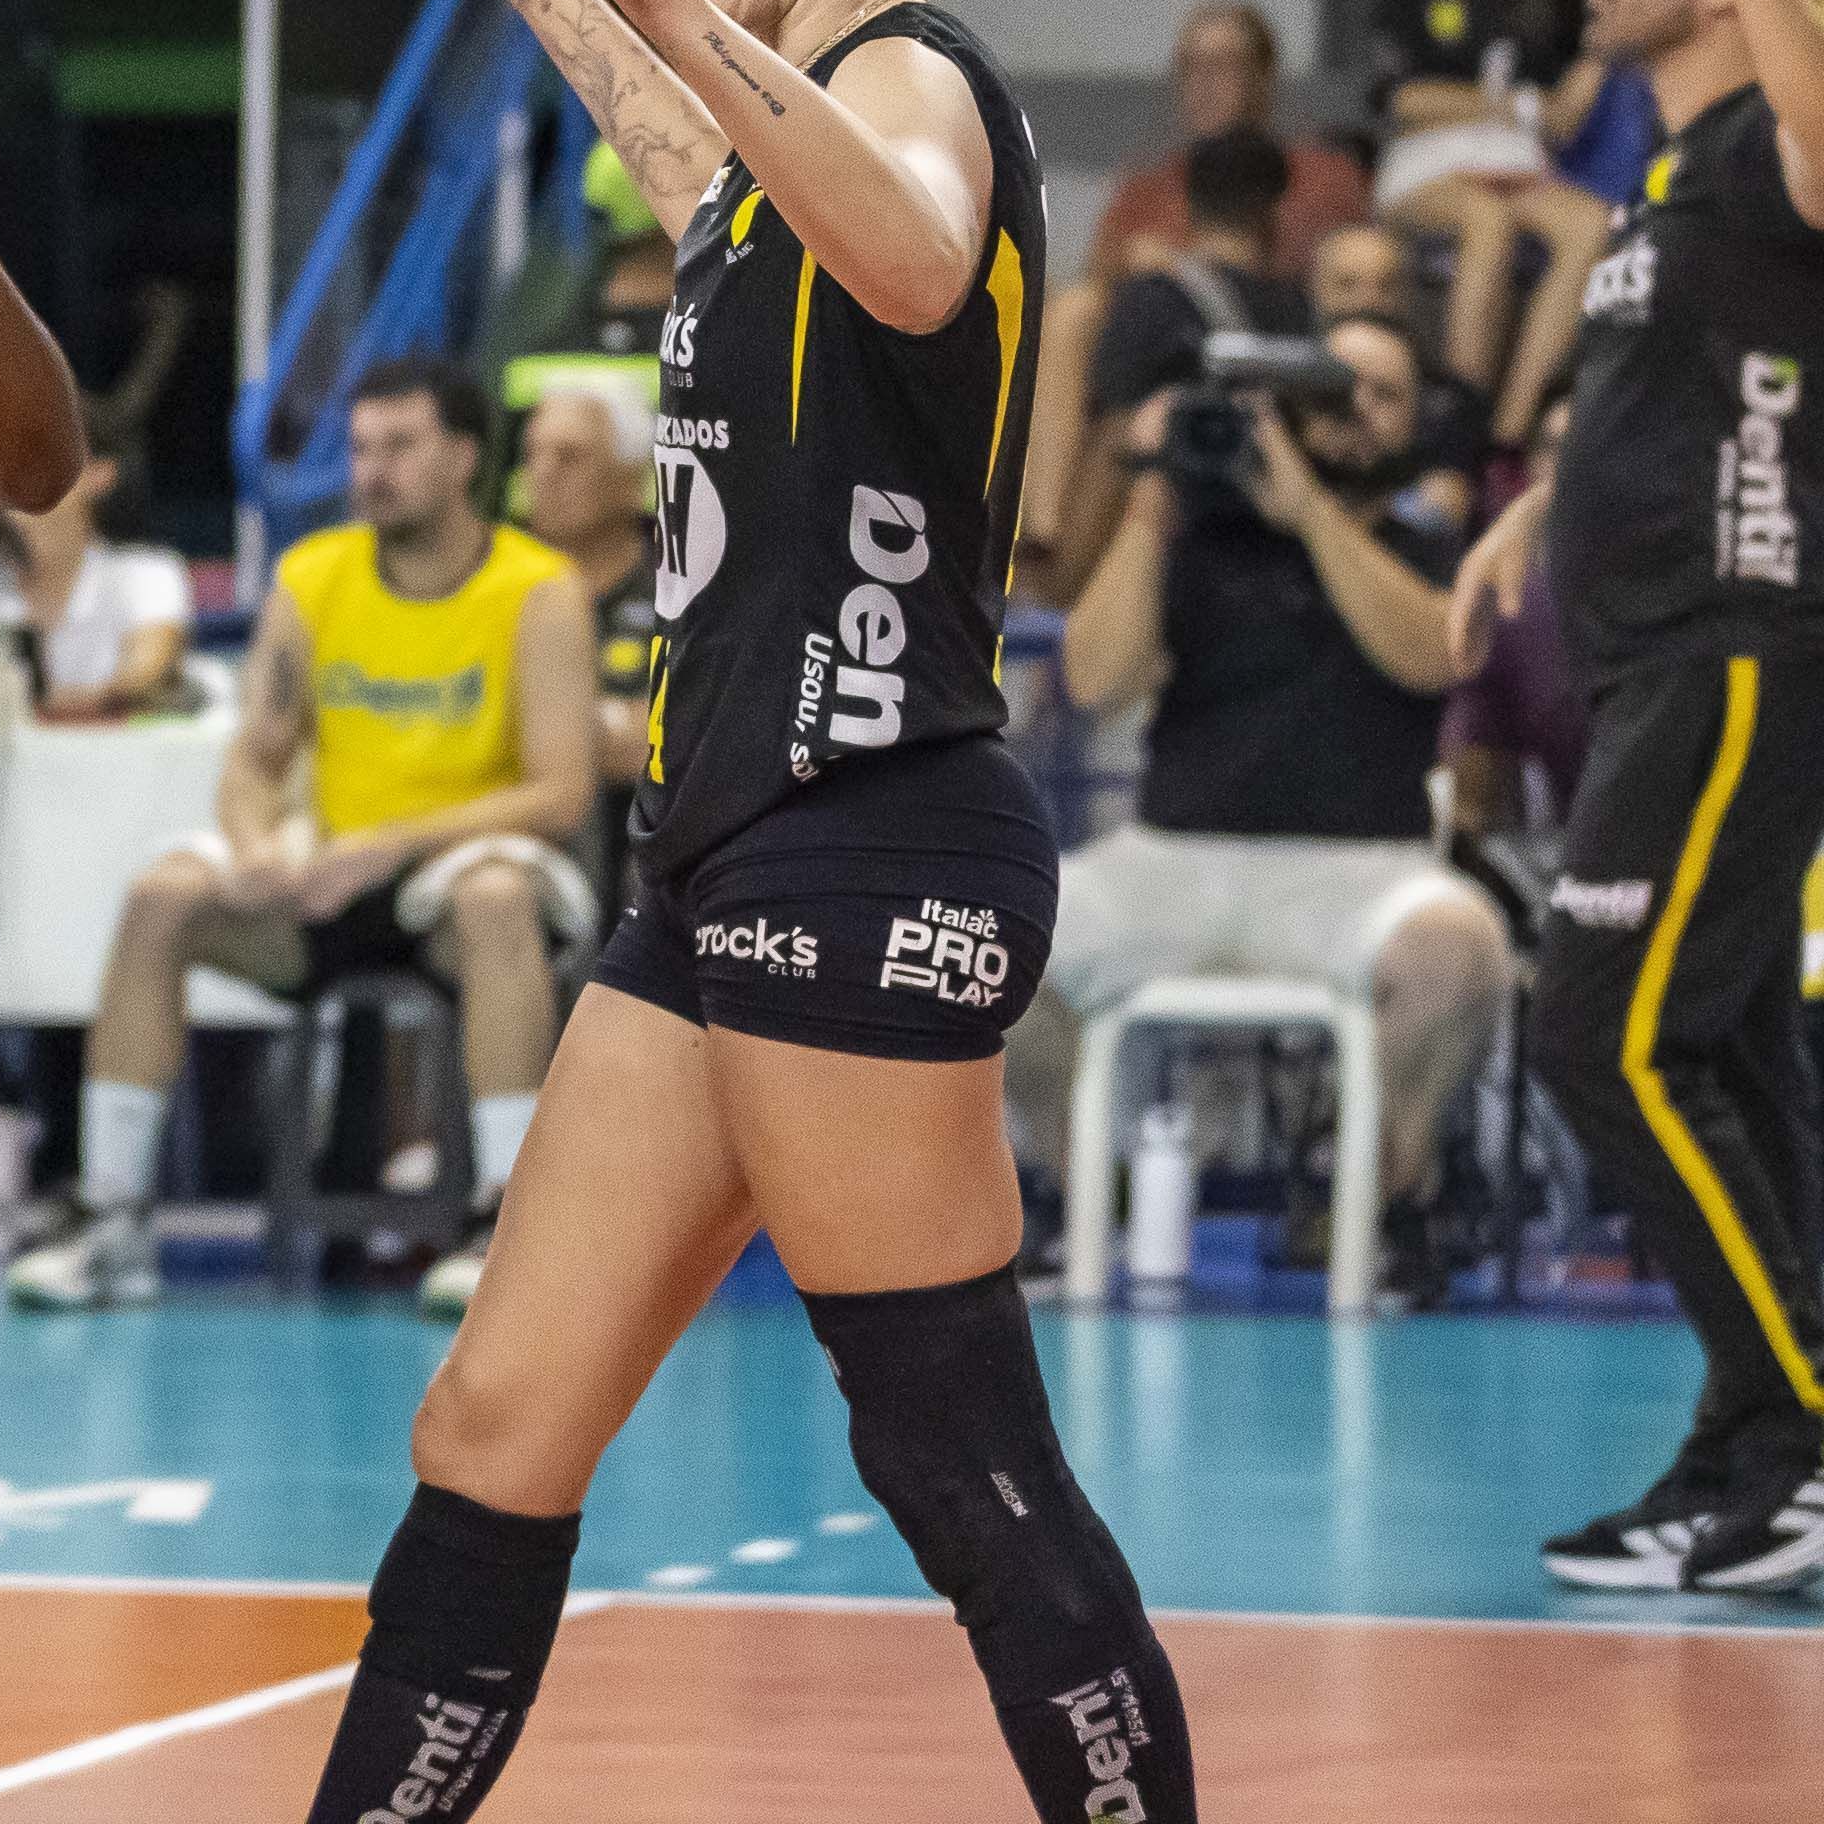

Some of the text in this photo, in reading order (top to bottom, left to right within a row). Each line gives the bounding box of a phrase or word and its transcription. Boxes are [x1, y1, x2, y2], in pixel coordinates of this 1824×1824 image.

[920, 898, 999, 940] Italac
[767, 963, 817, 979] CLUB
[884, 916, 1009, 987] PRO
[879, 961, 1003, 1007] PLAY
